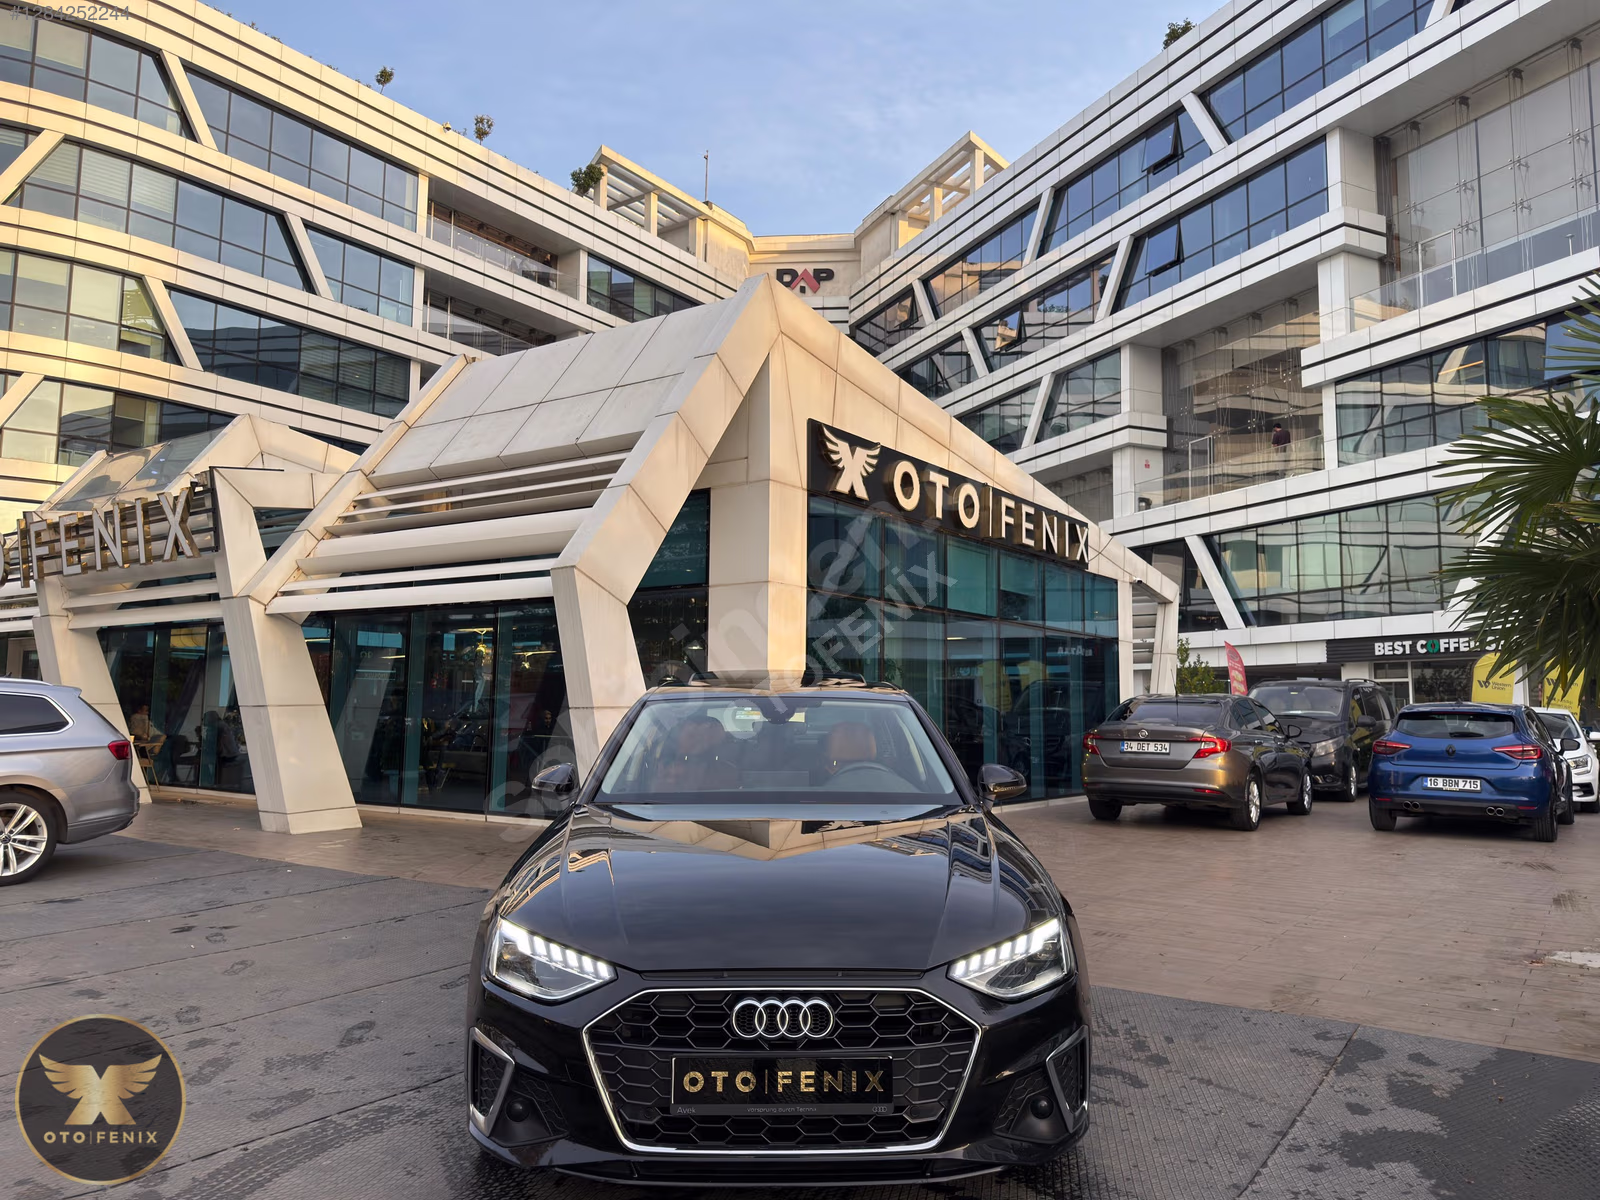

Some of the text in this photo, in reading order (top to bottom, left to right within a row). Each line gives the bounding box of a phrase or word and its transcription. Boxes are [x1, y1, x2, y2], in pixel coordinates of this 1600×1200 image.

[1374, 640, 1412, 656] BEST
[1124, 742, 1168, 752] 34 DET 534
[1428, 778, 1479, 789] 16 BBN 715
[683, 1070, 884, 1093] OTO FENIX
